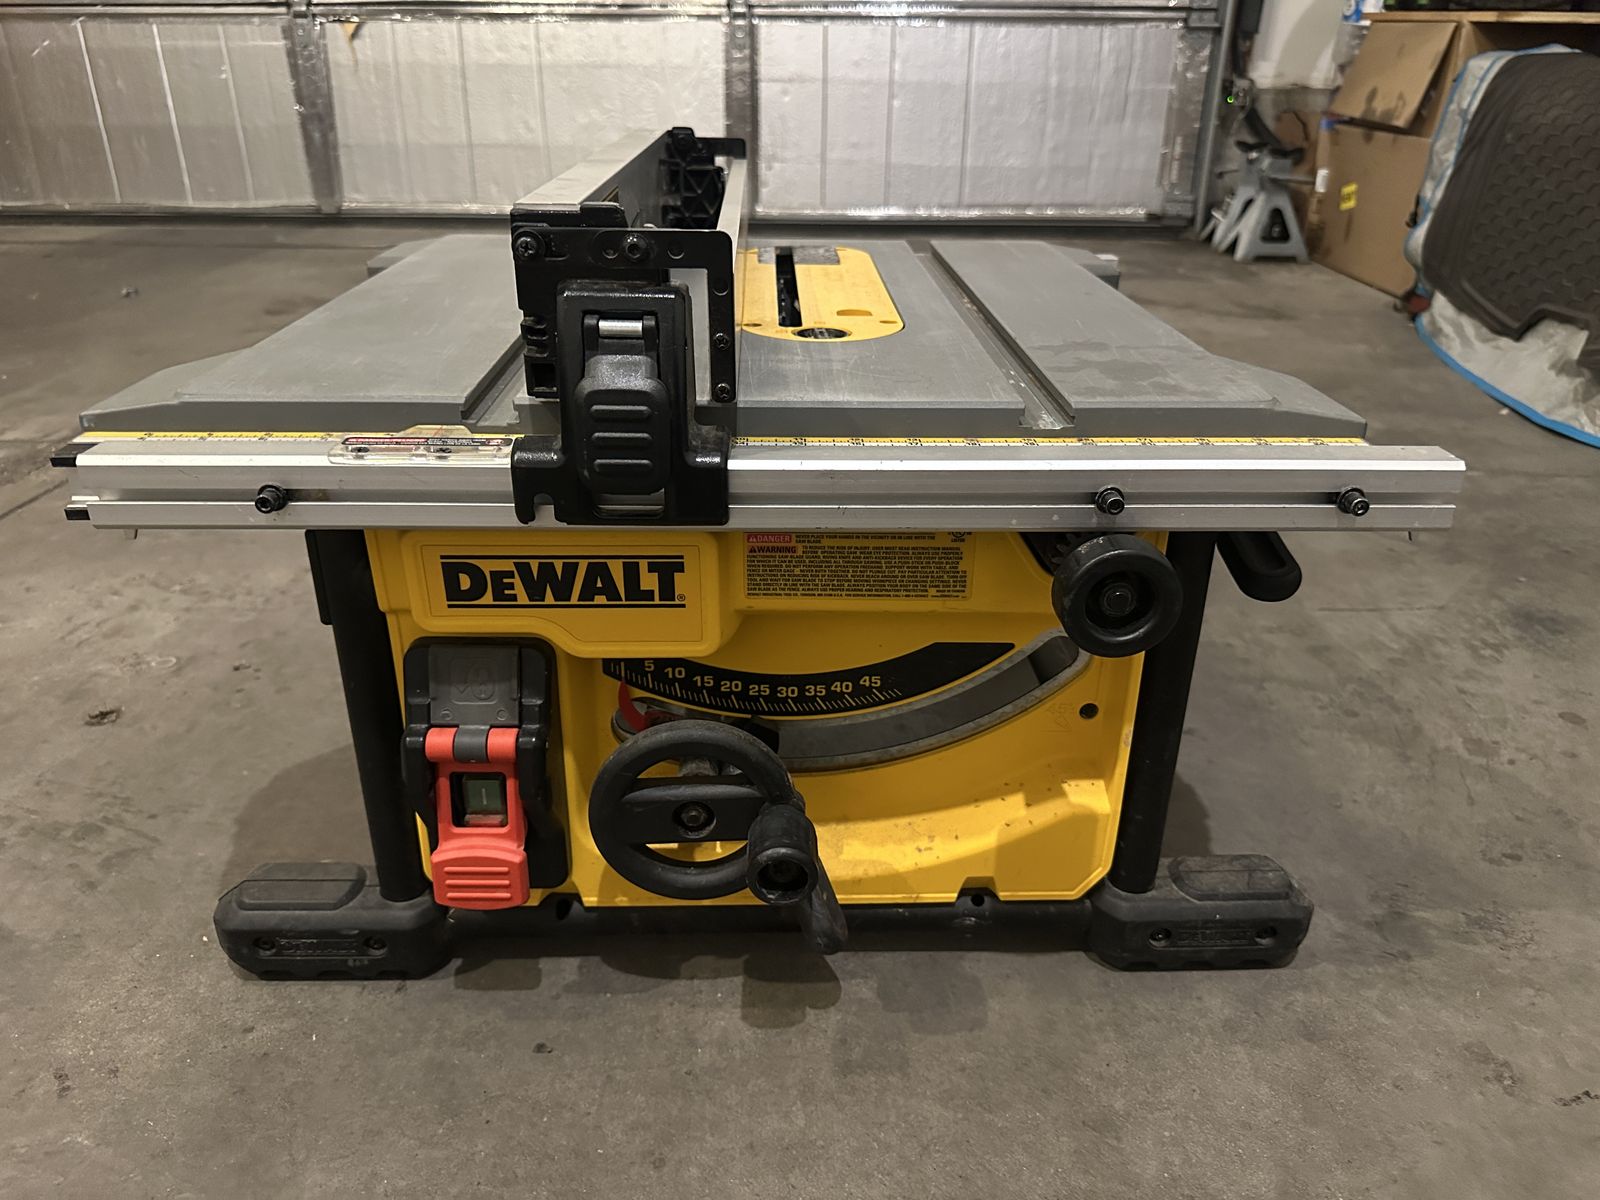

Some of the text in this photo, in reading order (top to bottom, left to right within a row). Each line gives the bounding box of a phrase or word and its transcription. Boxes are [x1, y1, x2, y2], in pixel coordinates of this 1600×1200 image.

[645, 660, 880, 697] 5 10 15 20 25 30 35 40 45
